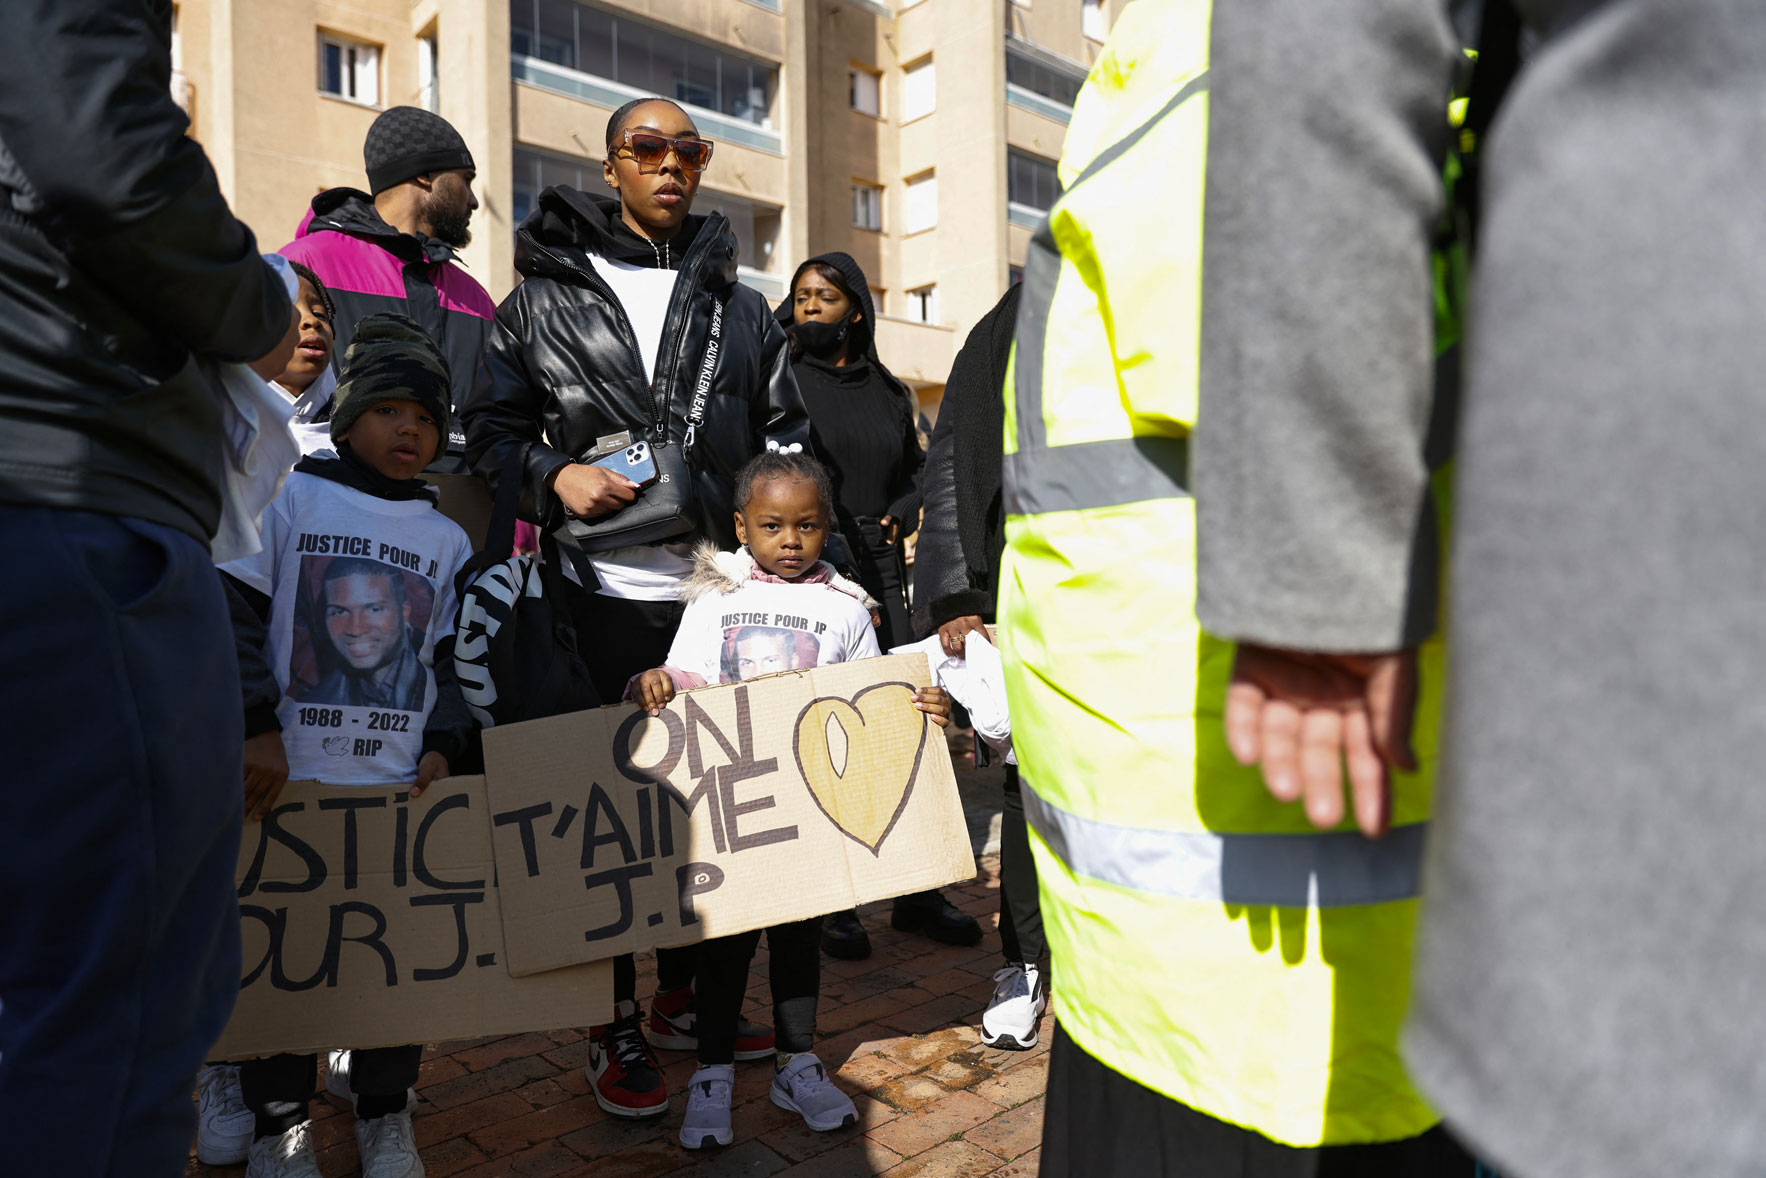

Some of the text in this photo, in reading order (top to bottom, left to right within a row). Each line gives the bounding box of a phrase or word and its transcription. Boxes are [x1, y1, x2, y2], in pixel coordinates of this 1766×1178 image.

[711, 312, 721, 337] JEANS
[703, 340, 719, 370] CALVIN
[696, 368, 713, 395] KLEIN
[296, 532, 372, 556] JUSTICE
[379, 542, 420, 572] POUR
[721, 612, 827, 635] JUSTICE POUR JP
[298, 707, 343, 728] 1988
[367, 711, 410, 733] 2022
[612, 685, 754, 784] ON
[352, 738, 383, 757] RIP
[493, 758, 799, 877] T'AIME
[585, 861, 724, 942] J.P
[239, 901, 398, 992] OUR
